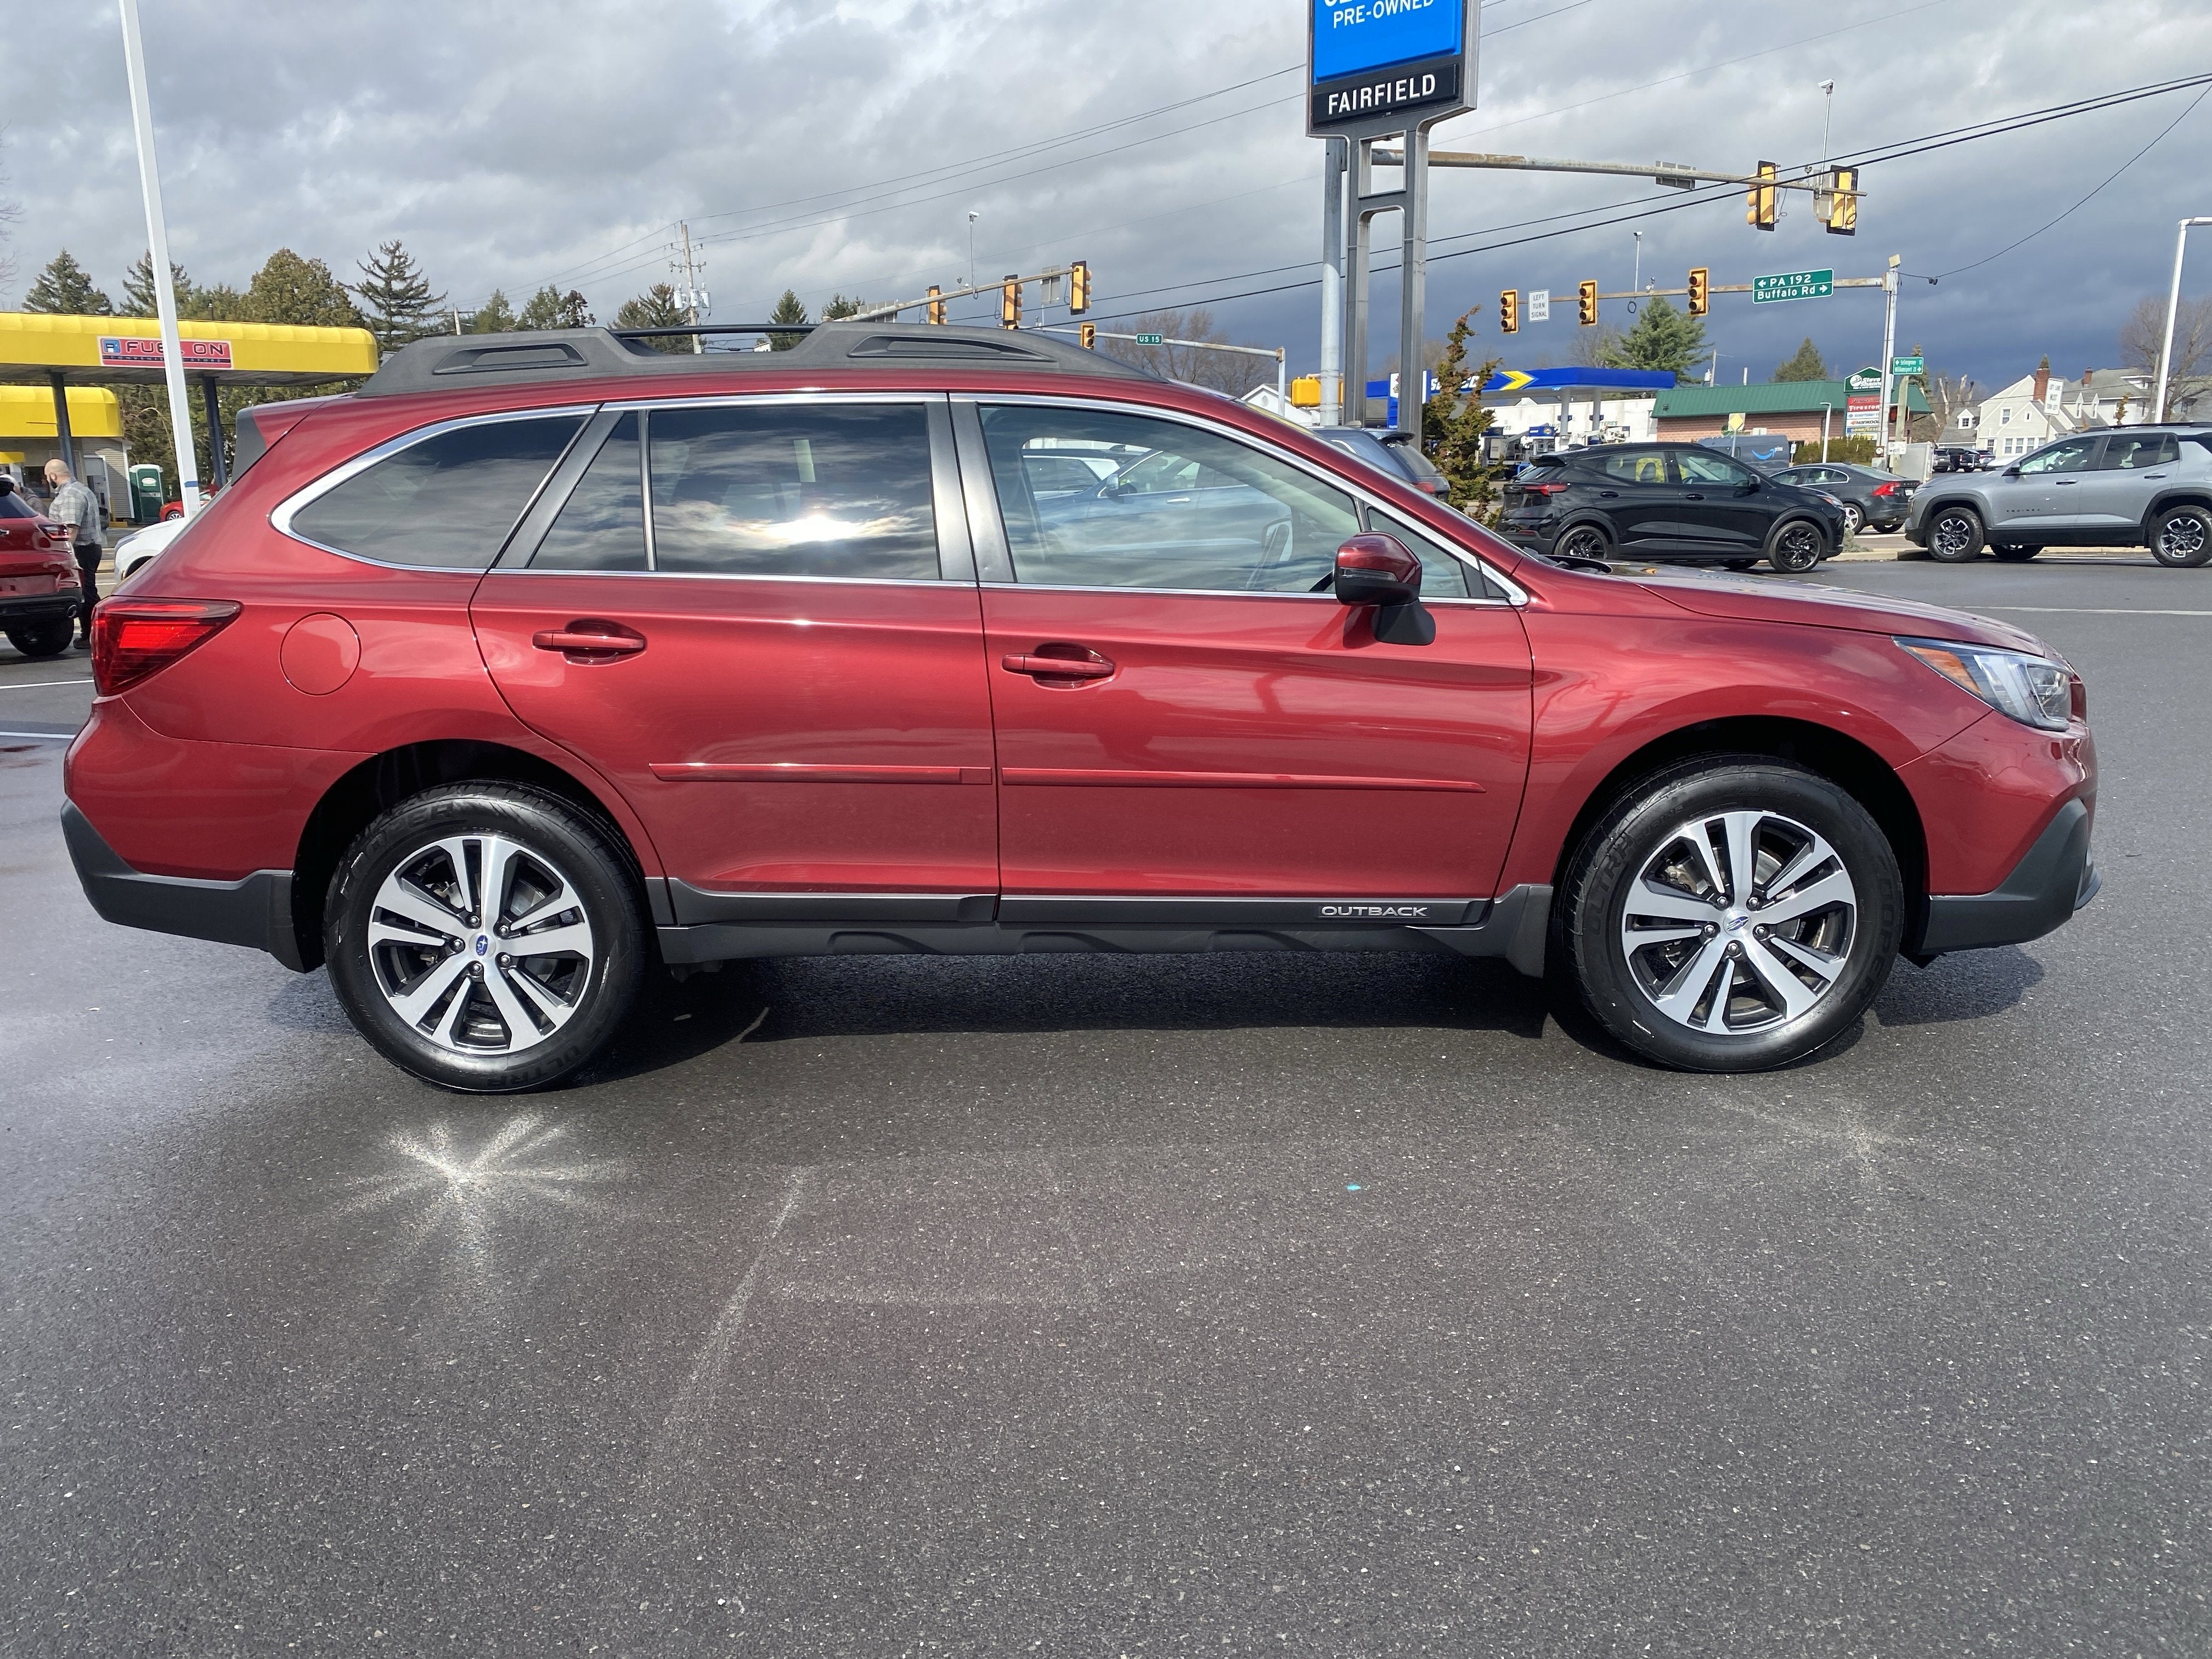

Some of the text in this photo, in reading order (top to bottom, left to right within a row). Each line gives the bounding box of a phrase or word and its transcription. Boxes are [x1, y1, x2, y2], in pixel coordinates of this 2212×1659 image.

[1328, 74, 1436, 115] FAIRFIELD
[1769, 274, 1811, 287] PA 192
[1757, 285, 1815, 300] Buffalo Rd
[126, 341, 224, 356] FUE ON
[1321, 906, 1427, 917] OUTBACK
